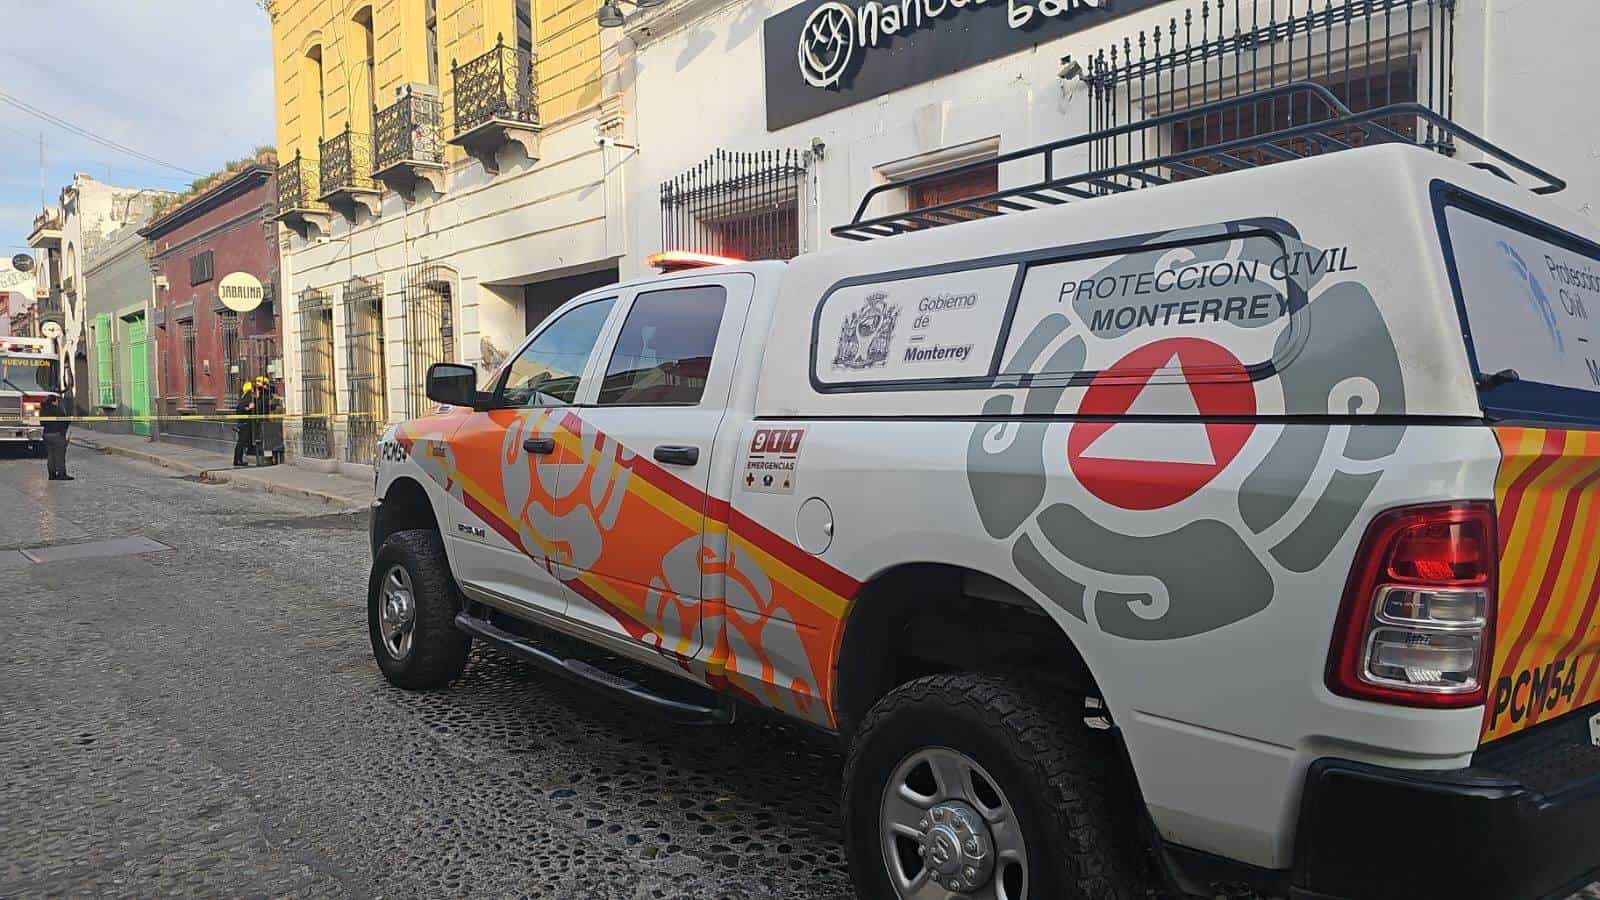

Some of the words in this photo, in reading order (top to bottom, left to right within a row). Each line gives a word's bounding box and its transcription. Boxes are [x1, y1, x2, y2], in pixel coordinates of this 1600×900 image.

[1058, 258, 1260, 303] PROTECCION
[1269, 246, 1358, 282] CIVIL
[220, 285, 262, 299] JABALINA
[918, 292, 977, 312] Gobierno
[913, 314, 930, 329] de
[1090, 292, 1294, 332] MONTERREY
[903, 345, 972, 364] Monterrey
[755, 432, 798, 450] 911
[381, 441, 407, 463] PCM54
[747, 461, 795, 471] EMERGENCIAS
[1489, 656, 1579, 731] PCM54
